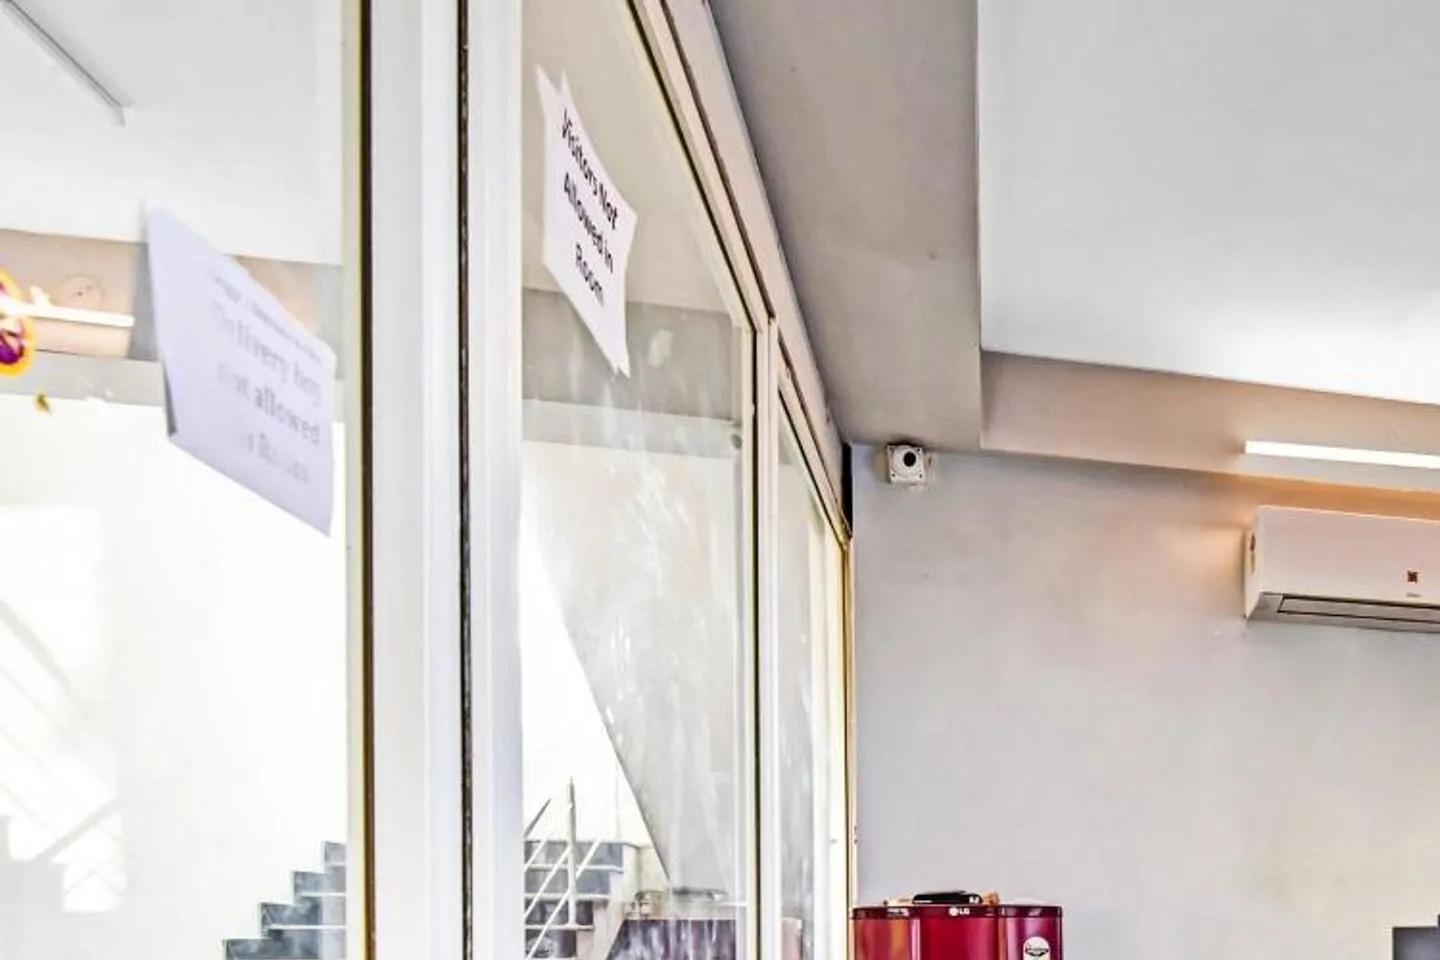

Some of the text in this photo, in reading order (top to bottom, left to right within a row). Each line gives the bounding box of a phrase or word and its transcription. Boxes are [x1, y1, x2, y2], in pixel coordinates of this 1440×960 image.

[564, 171, 613, 273] Allowed in
[599, 182, 618, 230] Not
[576, 242, 603, 306] Room
[253, 385, 320, 446] allowed
